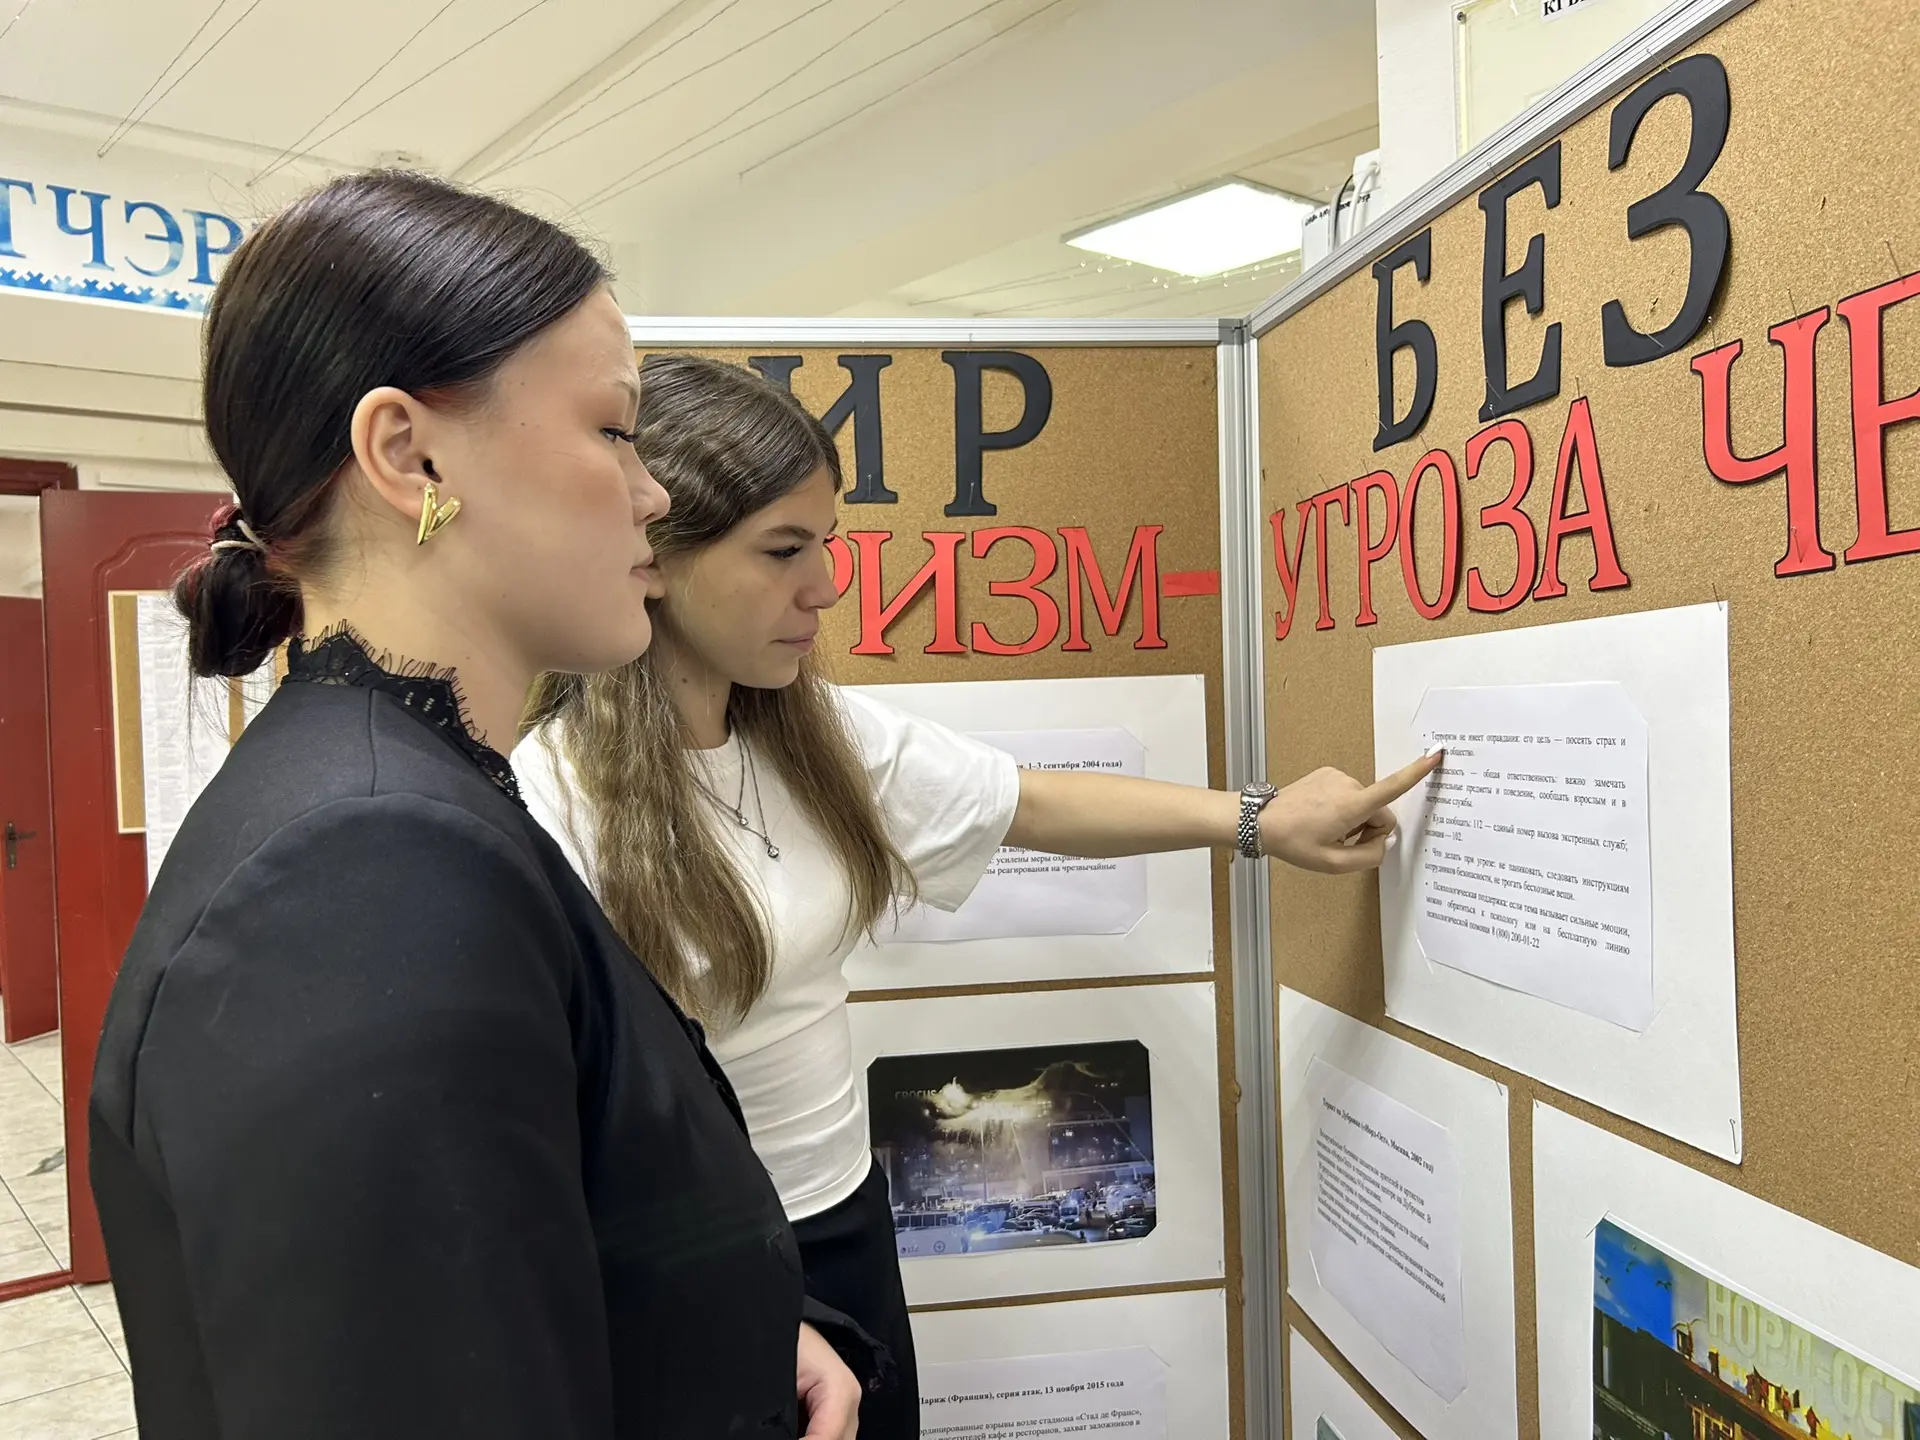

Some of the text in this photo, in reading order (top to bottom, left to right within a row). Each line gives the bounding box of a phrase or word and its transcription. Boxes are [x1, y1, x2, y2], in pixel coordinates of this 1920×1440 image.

[1372, 53, 1732, 452] БЕЗ
[641, 350, 1052, 517] ИР
[1269, 395, 1630, 640] УГРОЗА
[1523, 736, 1533, 744] его
[1536, 736, 1551, 744] цель
[1566, 736, 1592, 745] посеять
[1596, 738, 1616, 748] страх
[1620, 738, 1626, 746] и
[1043, 760, 1080, 770] сентября
[1082, 760, 1100, 768] 2004
[1102, 760, 1123, 768] года)
[1565, 777, 1586, 786] важно
[1594, 779, 1626, 788] замечать
[1466, 784, 1492, 794] предметы
[1539, 790, 1570, 802] сообщать
[1574, 796, 1606, 806] взрослым
[1611, 798, 1616, 806] и
[1622, 800, 1626, 808] в
[1474, 820, 1483, 829] 112
[1493, 824, 1514, 834] единый
[1516, 828, 1535, 839] номер
[1537, 830, 1558, 840] вызова
[1562, 833, 1600, 846] экстренных
[996, 857, 1029, 866] усилены
[1030, 856, 1050, 865] меры
[998, 866, 1050, 876] реагирования
[1062, 863, 1117, 874] чрезвычайные
[1502, 878, 1522, 890] трогать
[1523, 880, 1556, 896] бесхозные
[1556, 890, 1575, 900] вещи.
[1546, 871, 1578, 884] следовать
[1582, 878, 1630, 894] инструкциям
[1508, 902, 1522, 911] если
[1524, 904, 1538, 915] тема
[1540, 908, 1569, 922] вызывает
[1570, 916, 1599, 929] сильные
[1600, 922, 1630, 938] эмоции,
[1510, 931, 1540, 948] 200-01-22
[1524, 921, 1536, 931] или
[1542, 926, 1550, 934] на
[1557, 928, 1598, 948] бесплатную
[1604, 942, 1630, 956] линию
[948, 1392, 994, 1404] (Франция),
[996, 1390, 1020, 1399] серия
[1022, 1388, 1043, 1396] атак,
[1045, 1386, 1054, 1394] 13
[1056, 1384, 1084, 1392] ноября
[1086, 1380, 1105, 1390] 2015
[1106, 1380, 1124, 1388] года
[986, 1422, 1014, 1431] взрывы
[1039, 1416, 1074, 1425] стадиона
[1076, 1412, 1099, 1421] «Стад
[988, 1431, 1007, 1440] кафе
[1016, 1428, 1061, 1438] ресторанов,
[1063, 1424, 1087, 1432] захват
[1089, 1420, 1134, 1430] заложников
